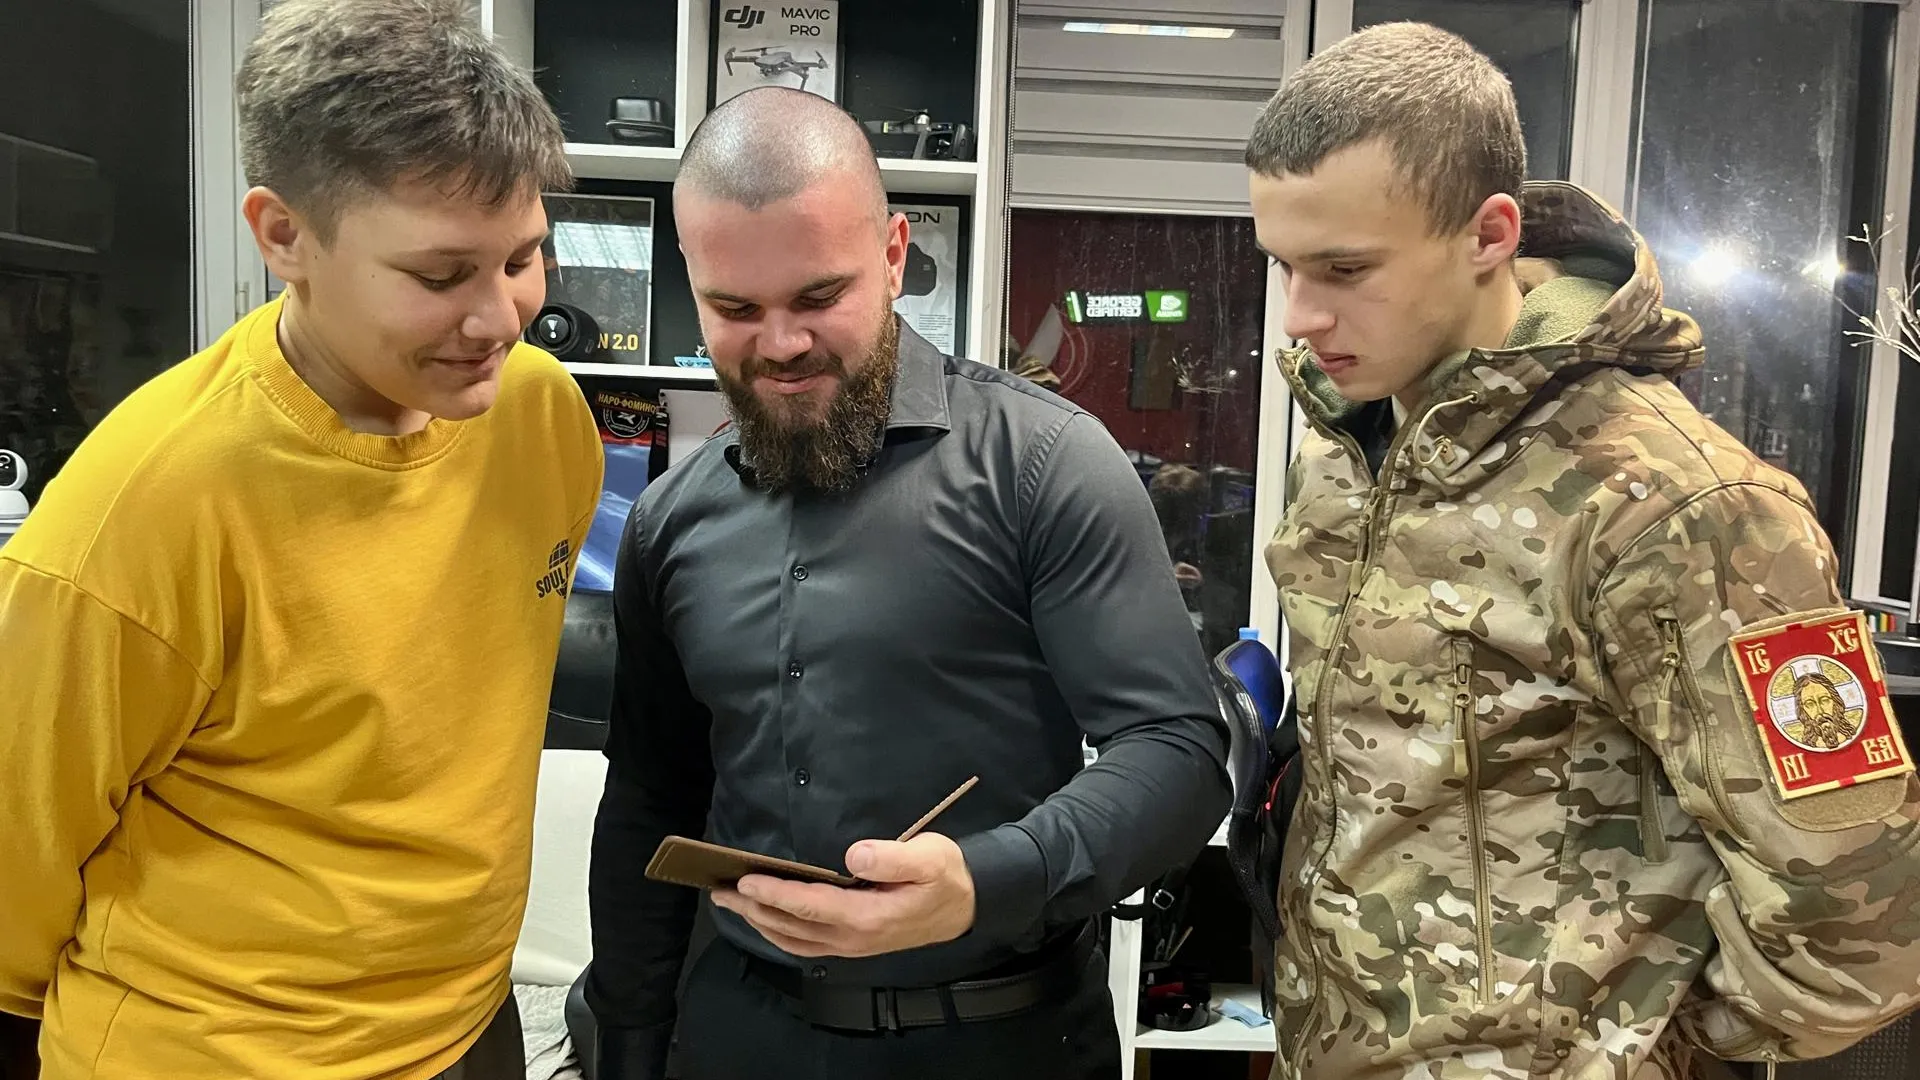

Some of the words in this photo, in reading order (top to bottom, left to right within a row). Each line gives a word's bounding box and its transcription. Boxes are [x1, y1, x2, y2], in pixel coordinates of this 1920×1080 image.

[781, 7, 831, 20] MAVIC
[790, 25, 820, 36] PRO
[612, 333, 639, 351] 2.0
